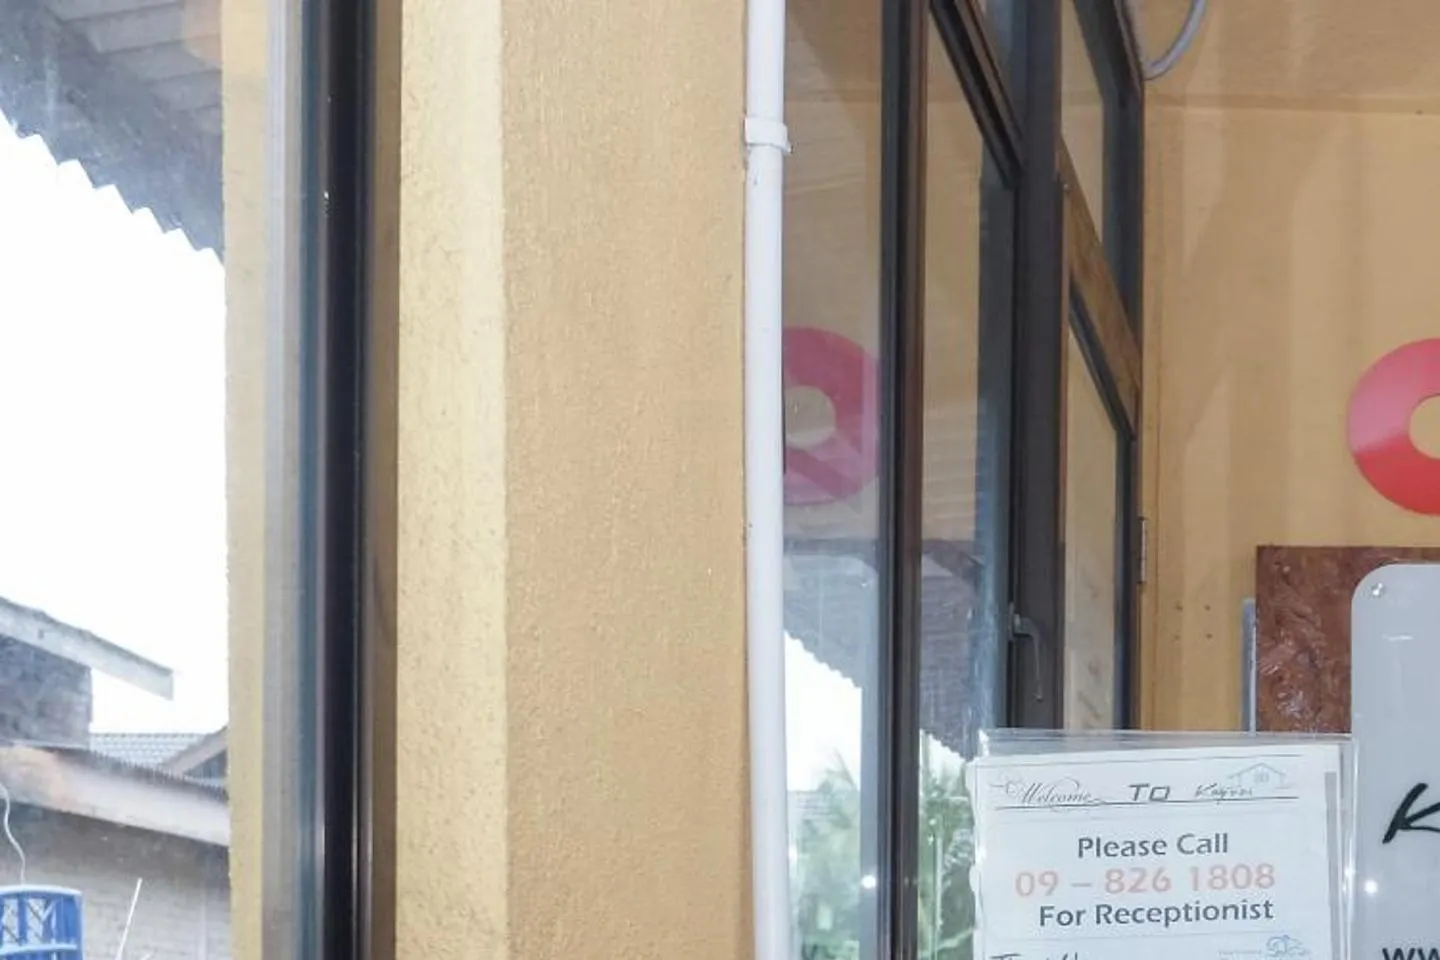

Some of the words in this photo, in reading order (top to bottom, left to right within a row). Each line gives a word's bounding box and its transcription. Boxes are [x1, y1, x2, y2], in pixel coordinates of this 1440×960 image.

[1127, 784, 1171, 802] TO
[1077, 834, 1168, 859] Please
[1176, 832, 1229, 856] Call
[1014, 870, 1060, 897] 09
[1103, 866, 1172, 895] 826
[1189, 863, 1276, 892] 1808
[1038, 904, 1087, 927] For
[1094, 898, 1275, 928] Receptionist
